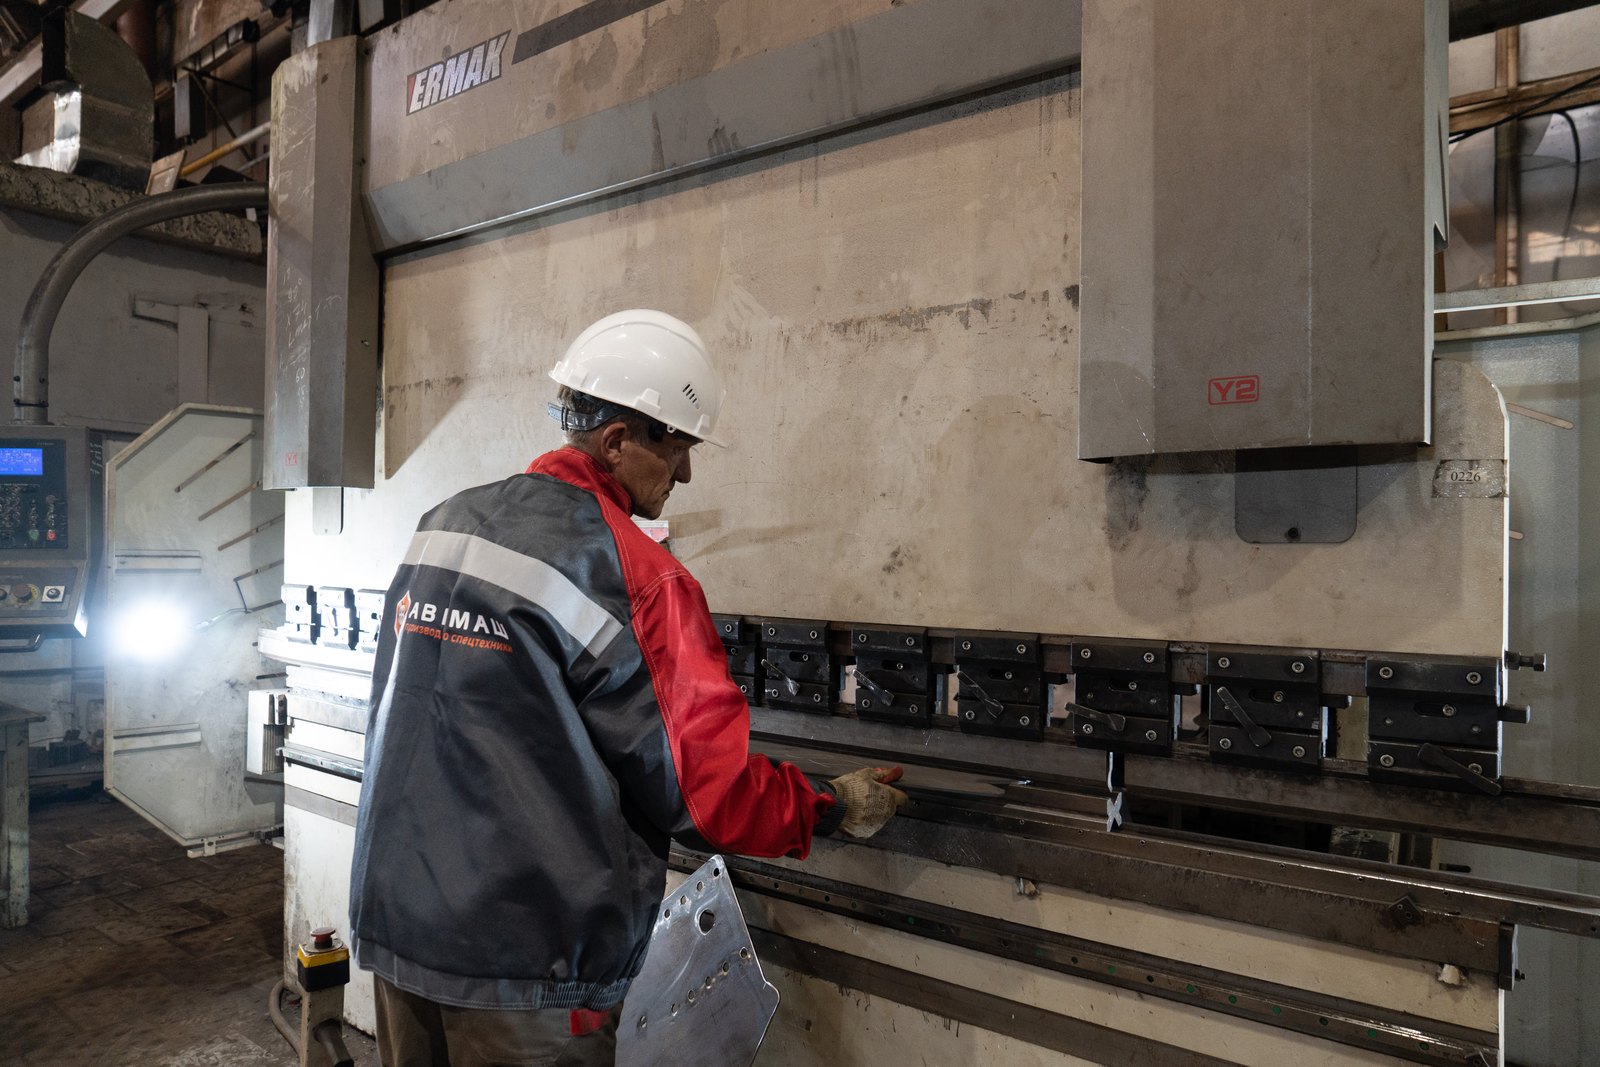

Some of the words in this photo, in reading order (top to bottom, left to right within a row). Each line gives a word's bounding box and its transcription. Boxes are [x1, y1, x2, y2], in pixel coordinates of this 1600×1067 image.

[407, 31, 510, 114] ERMAK
[1213, 379, 1256, 401] Y2
[1450, 471, 1481, 482] 0226
